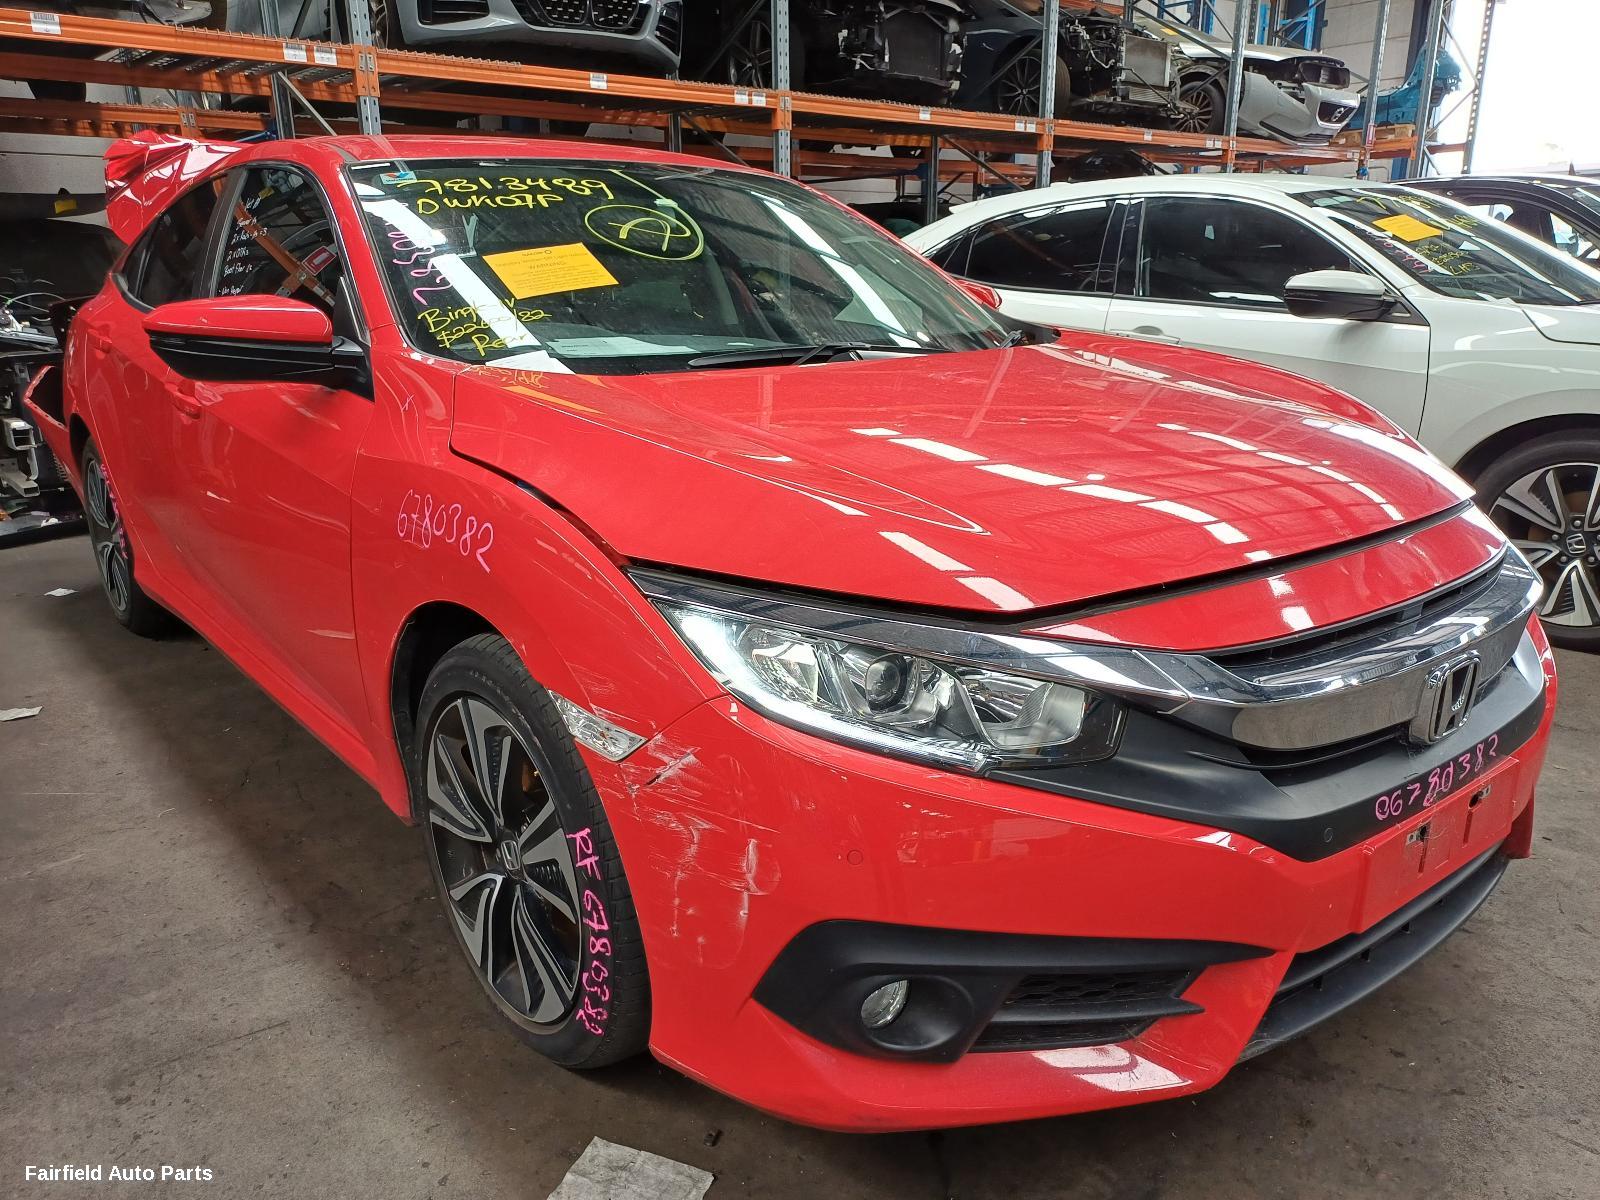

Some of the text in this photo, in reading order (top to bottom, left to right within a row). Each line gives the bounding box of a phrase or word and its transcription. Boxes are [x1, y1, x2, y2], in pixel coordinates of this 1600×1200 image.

[397, 177, 614, 200] 7813489
[397, 489, 494, 574] 6780382
[1375, 733, 1499, 821] 06780382
[566, 828, 601, 880] RF
